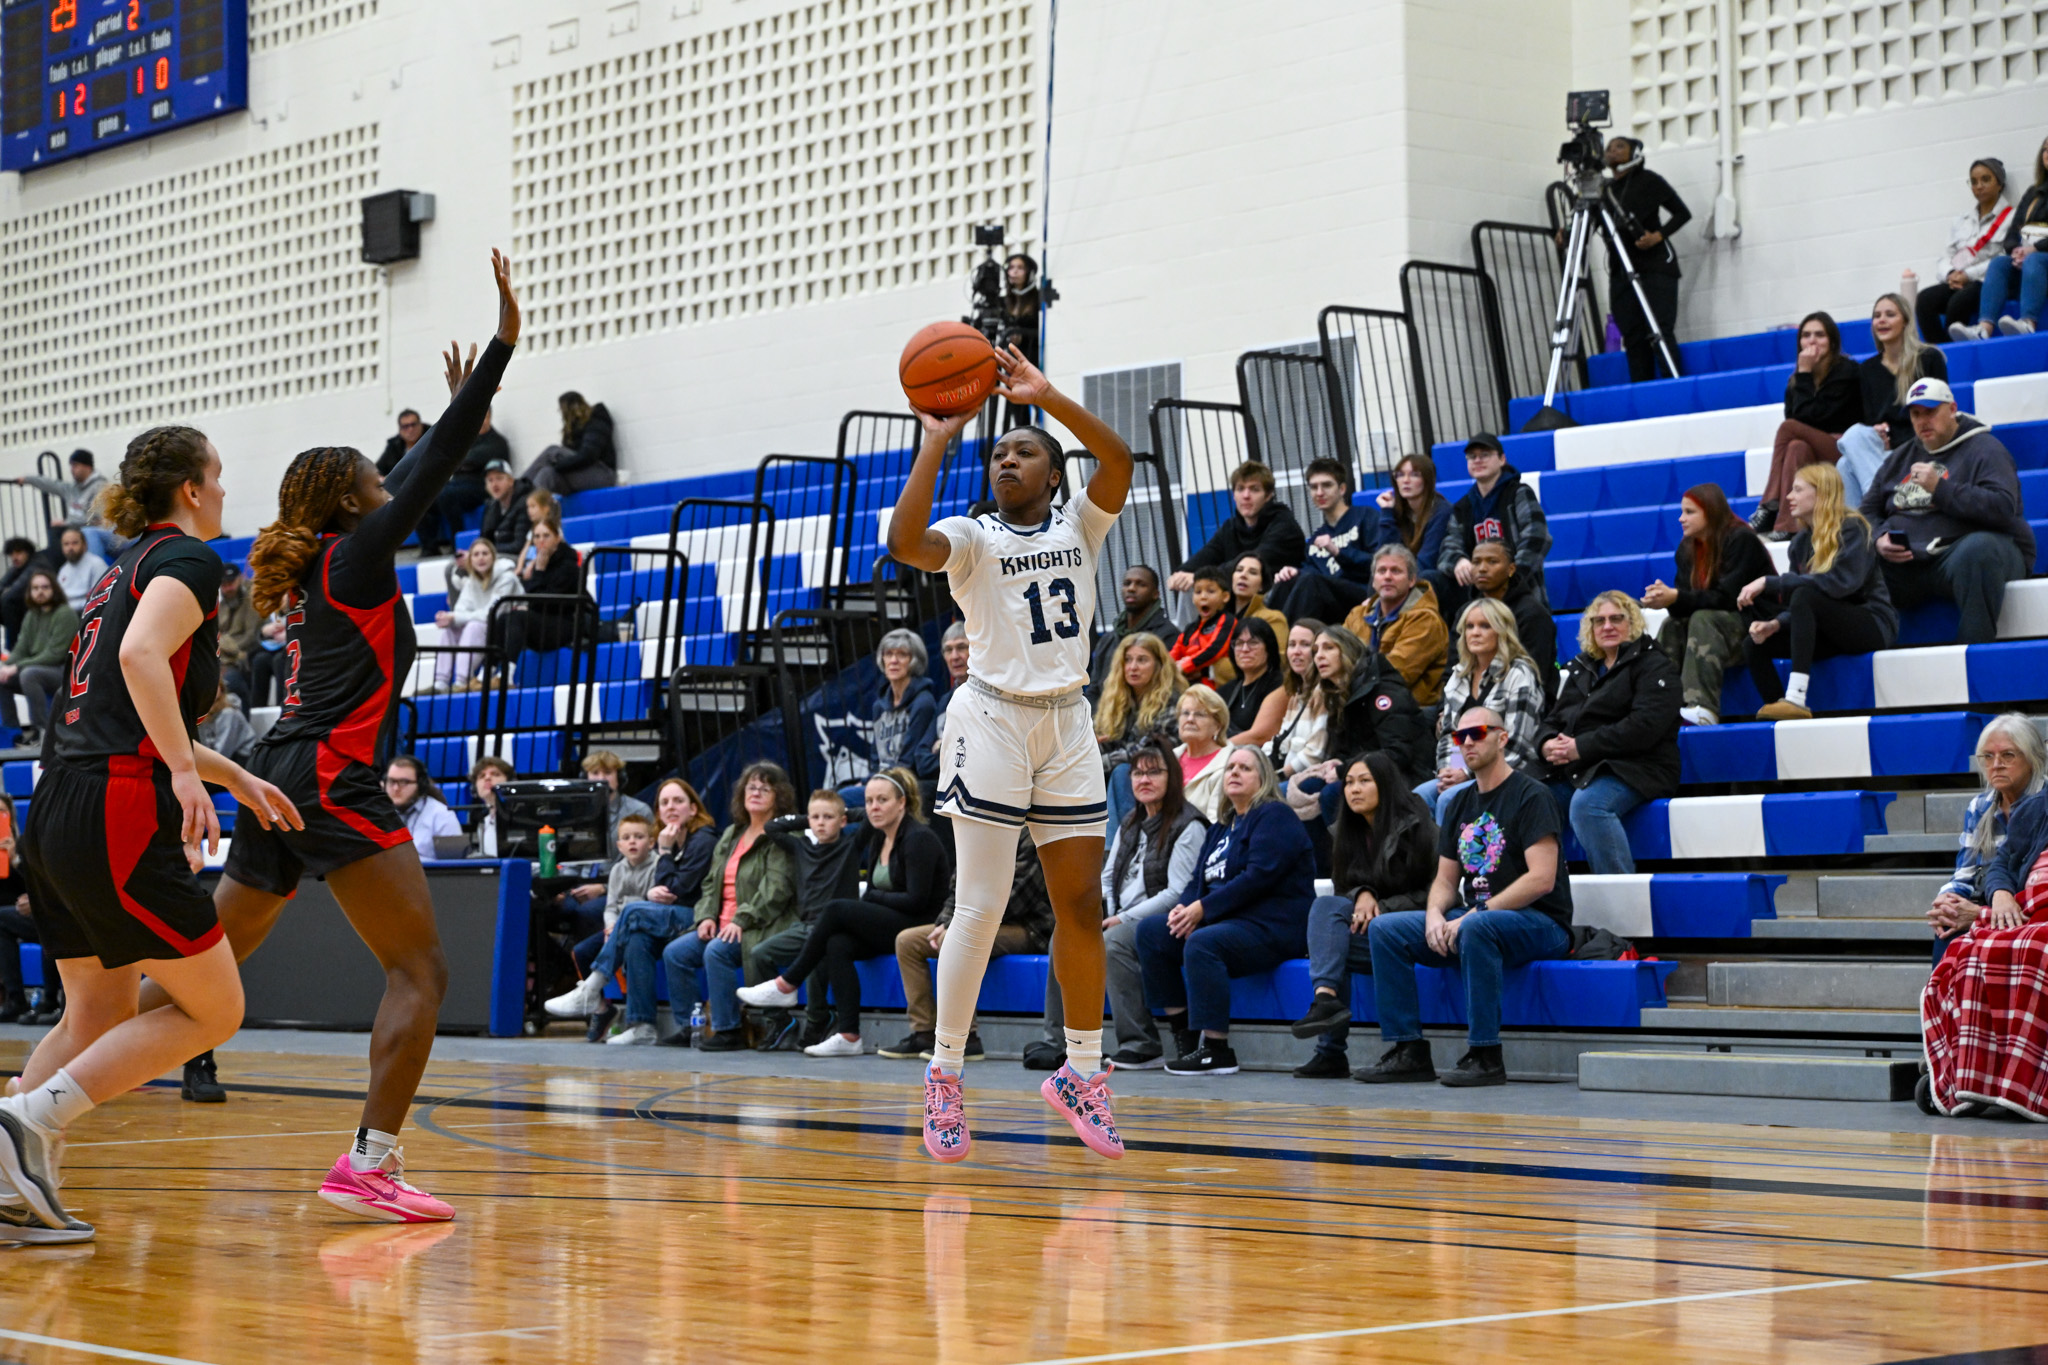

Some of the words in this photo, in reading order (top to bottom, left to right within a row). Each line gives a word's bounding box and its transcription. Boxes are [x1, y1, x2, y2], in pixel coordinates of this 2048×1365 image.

[95, 11, 122, 39] period
[127, 0, 139, 31] 2
[49, 62, 68, 83] fouls
[95, 45, 122, 70] player
[151, 28, 171, 51] fouls
[97, 115, 119, 139] game
[999, 547, 1082, 576] KNIGHTS
[1023, 578, 1080, 645] 13
